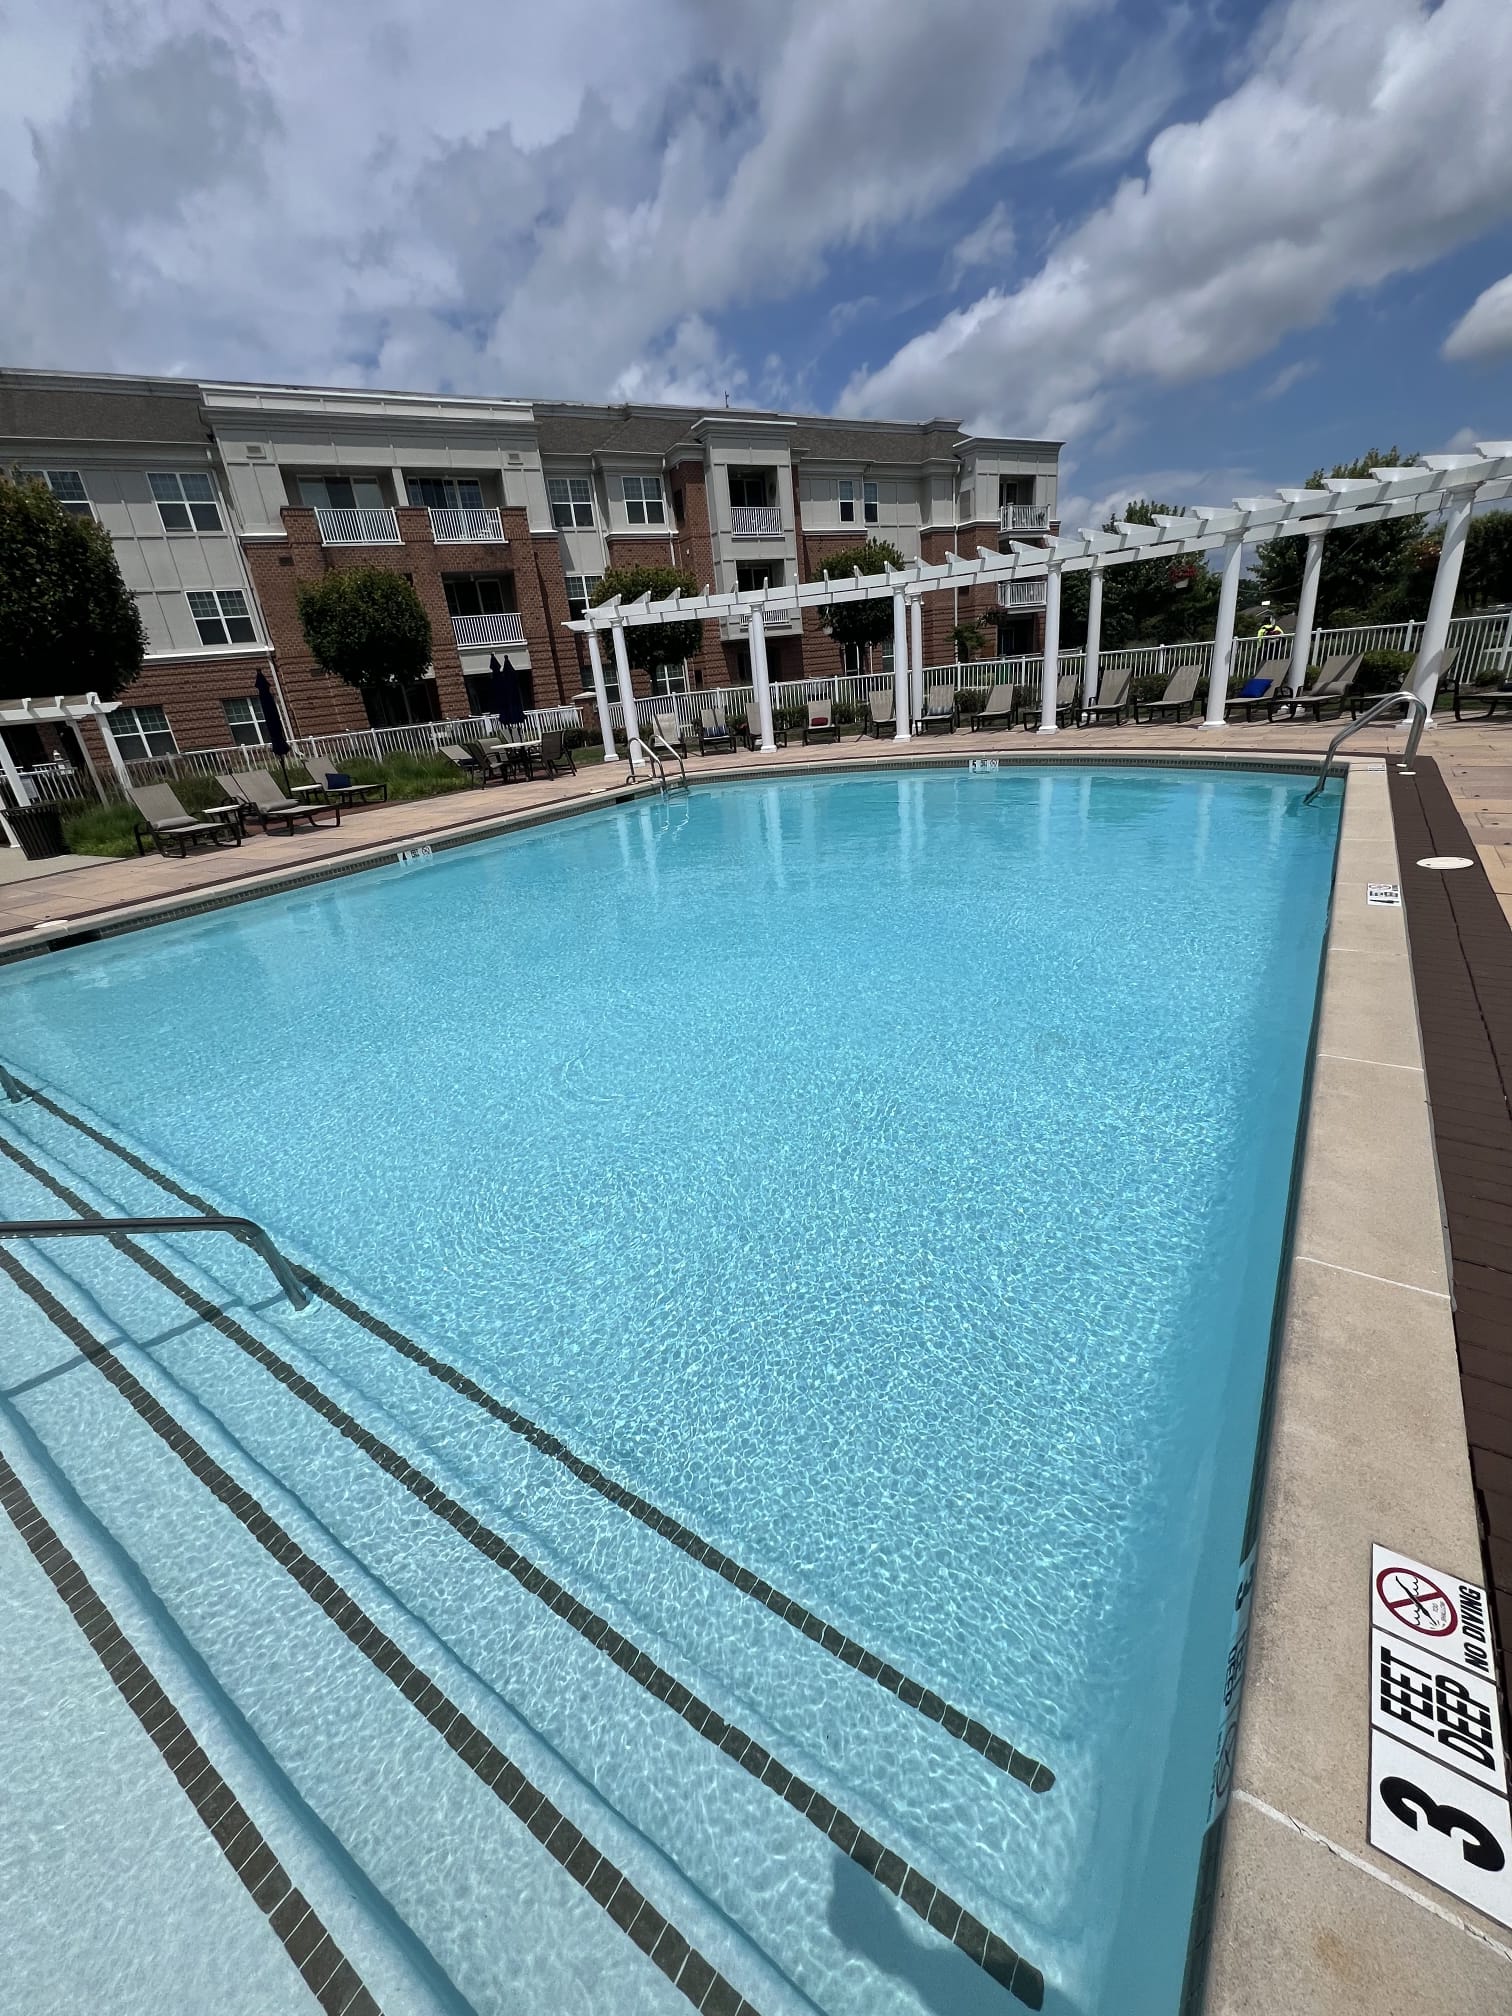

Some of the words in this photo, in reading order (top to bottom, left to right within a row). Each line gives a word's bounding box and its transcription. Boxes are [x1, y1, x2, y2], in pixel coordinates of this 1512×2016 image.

[1458, 1585, 1486, 1643] DIVING
[1463, 1642, 1489, 1673] NO
[1380, 1646, 1435, 1737] FEET
[1436, 1674, 1496, 1771] DEEP
[1380, 1776, 1506, 1872] 3
